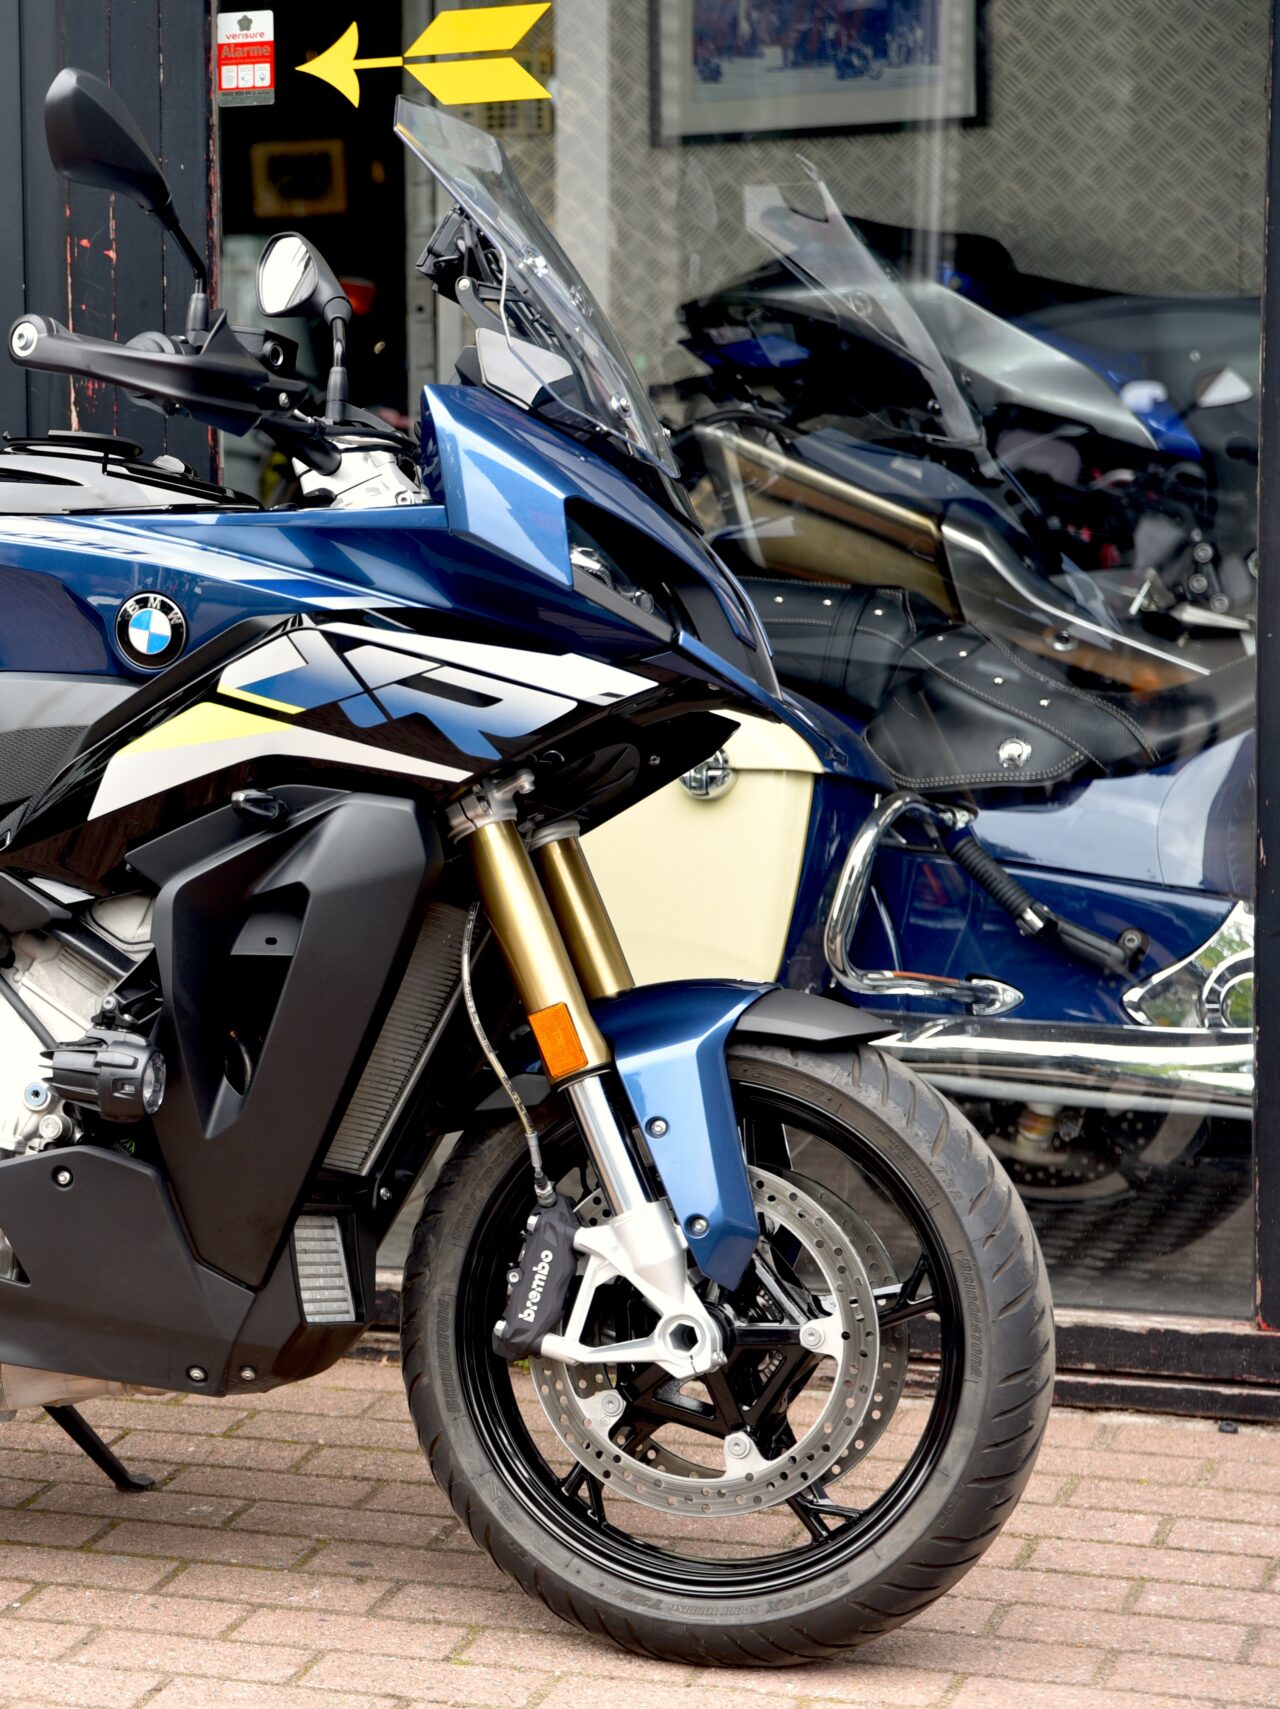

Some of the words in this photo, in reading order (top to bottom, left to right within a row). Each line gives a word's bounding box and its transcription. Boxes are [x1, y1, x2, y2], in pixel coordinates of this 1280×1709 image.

[221, 43, 271, 59] Alarme
[225, 31, 265, 40] verisure
[125, 595, 184, 626] BMW
[518, 1249, 554, 1323] brembo
[959, 1254, 985, 1378] BRIDGESTONE
[432, 1295, 465, 1415] BRIDGESTONE
